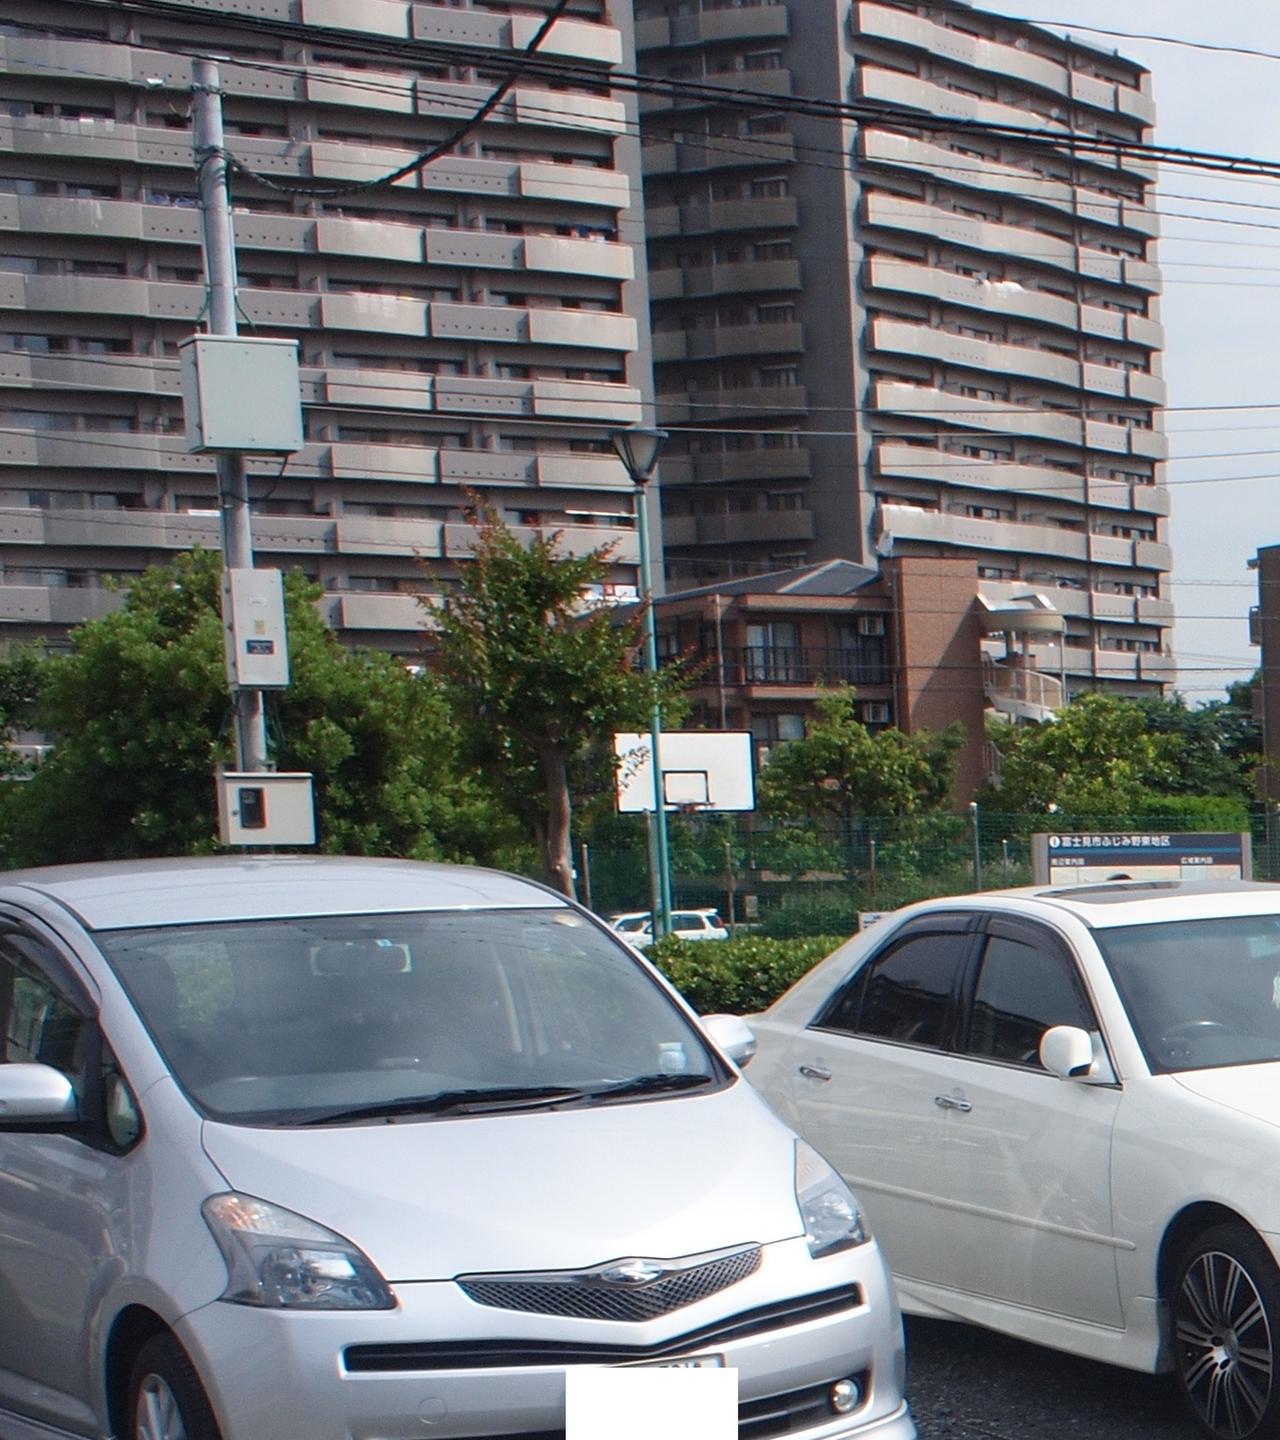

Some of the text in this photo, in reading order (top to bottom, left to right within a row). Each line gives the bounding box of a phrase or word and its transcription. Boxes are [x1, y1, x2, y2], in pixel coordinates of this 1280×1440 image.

[1061, 835, 1170, 848] 富士見市ふじみ野東地区
